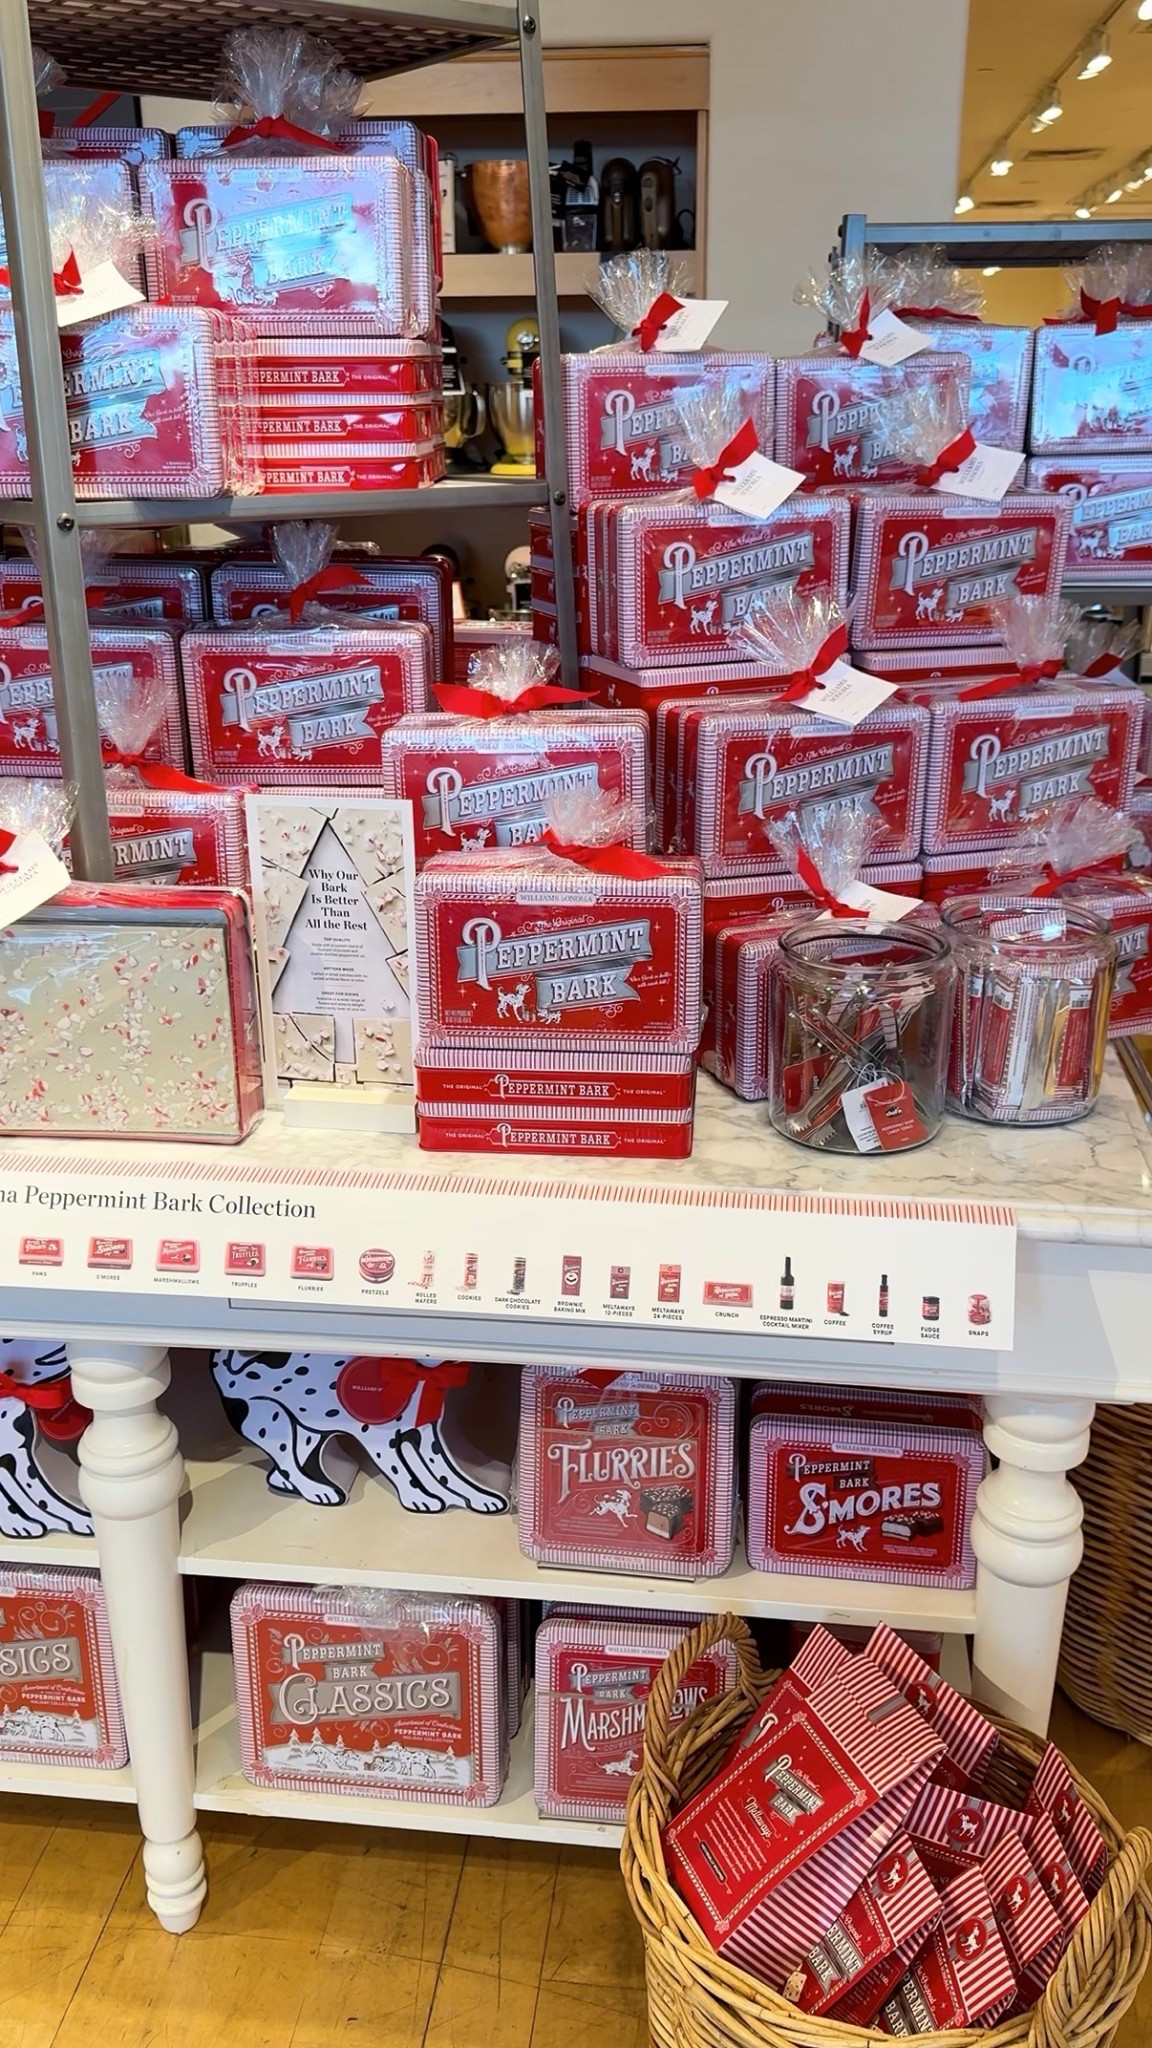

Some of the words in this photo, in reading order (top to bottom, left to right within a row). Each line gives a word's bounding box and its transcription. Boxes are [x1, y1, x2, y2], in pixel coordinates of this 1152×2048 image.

[312, 370, 339, 383] BARK
[69, 409, 134, 445] BARK
[313, 420, 341, 432] BARK
[316, 470, 344, 483] BARK
[663, 541, 809, 610] PEPPERMINT
[898, 531, 1031, 597] PEPPERMINT
[957, 575, 1005, 605] BARK
[224, 667, 376, 733] PEPPERMINT
[303, 715, 356, 742] BARK
[970, 733, 1105, 799] PEPPERMINT
[745, 751, 889, 820] PEPPERMINT
[1031, 774, 1079, 804] BARK
[426, 767, 594, 837] PEPPERMINT
[309, 869, 334, 882] Why
[336, 870, 359, 881] Our
[321, 883, 348, 893] Bark
[311, 894, 323, 905] Is
[325, 895, 360, 906] Better
[519, 893, 559, 902] WILLIAMS
[305, 919, 321, 929] All
[324, 920, 341, 930] the
[344, 921, 368, 931] Rest
[321, 908, 351, 918] Than
[462, 918, 644, 990] PEPPERMINT
[552, 975, 617, 1005] BARK
[494, 1074, 576, 1099] PEPPERMINT
[578, 1085, 610, 1097] BARK
[496, 1122, 576, 1148] PEPPERMINT
[579, 1134, 611, 1145] BARK
[25, 1185, 148, 1210] Peppermint
[153, 1191, 203, 1213] Bark
[208, 1193, 316, 1219] Collection
[153, 1277, 200, 1285] MARSHMALLOWS
[510, 1297, 541, 1305] CHOCOLATE
[557, 1300, 583, 1308] BROWNIE
[651, 1307, 685, 1315] MELTAWAYS
[653, 1313, 683, 1321] 24-PIECES
[760, 1314, 788, 1322] ESPRESSO
[789, 1316, 813, 1324] MARTINI
[762, 1321, 791, 1329] COCKTAIL
[871, 1322, 894, 1330] COFFEE
[557, 1397, 638, 1429] PEPPERMINT
[599, 1424, 629, 1435] BARK
[548, 1439, 695, 1505] FLURRIES
[789, 1453, 871, 1483] PEPPERMINT
[839, 1477, 870, 1489] BARK
[784, 1482, 942, 1536] S'MORES
[283, 1633, 382, 1670] PEPPERMINT
[332, 1666, 368, 1679] BARK
[571, 1662, 647, 1694] PEPPERMINT
[22, 1693, 65, 1702] PEPPERMINT
[66, 1695, 86, 1703] BARK
[279, 1672, 451, 1726] CLASSICS
[394, 1728, 440, 1738] PEPPERMINT
[442, 1732, 462, 1740] BARK
[765, 1754, 822, 1812] PEPPERMINT
[773, 1797, 798, 1819] BARK
[808, 1945, 834, 1982] BARK
